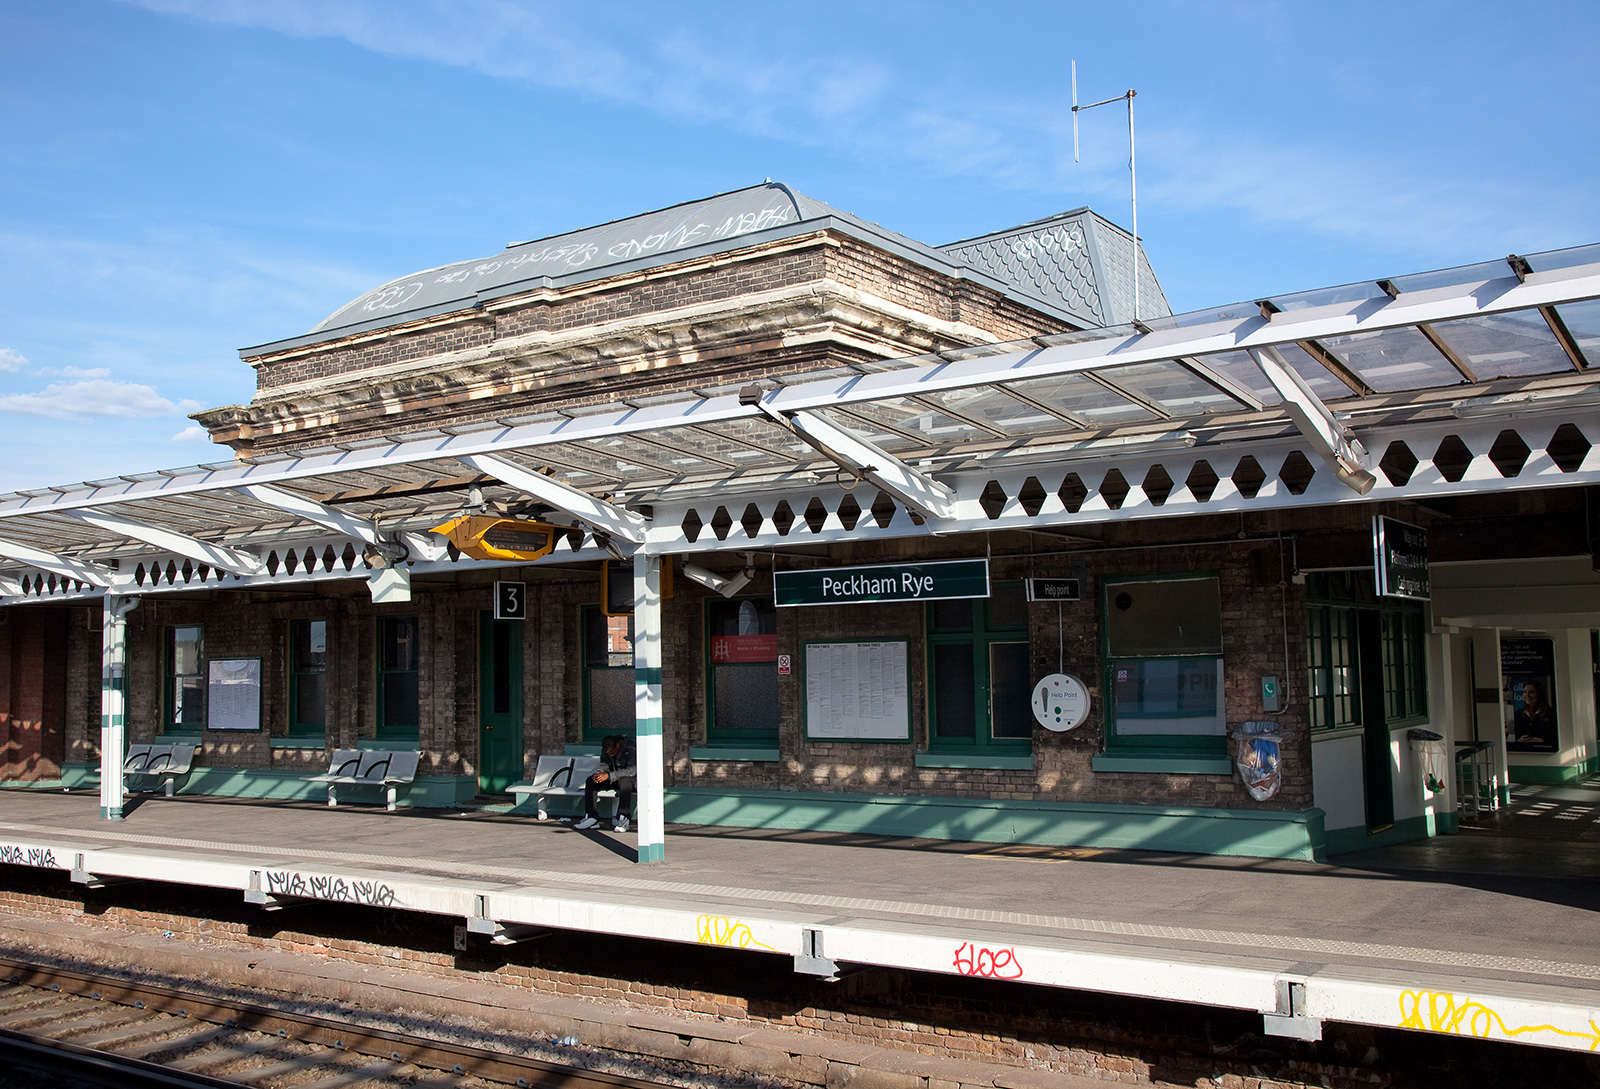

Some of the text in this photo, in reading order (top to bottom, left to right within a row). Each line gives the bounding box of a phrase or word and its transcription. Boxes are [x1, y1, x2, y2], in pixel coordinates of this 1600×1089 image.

[822, 572, 934, 598] Peckham Rye
[1044, 584, 1070, 598] Help point
[506, 588, 518, 612] 3
